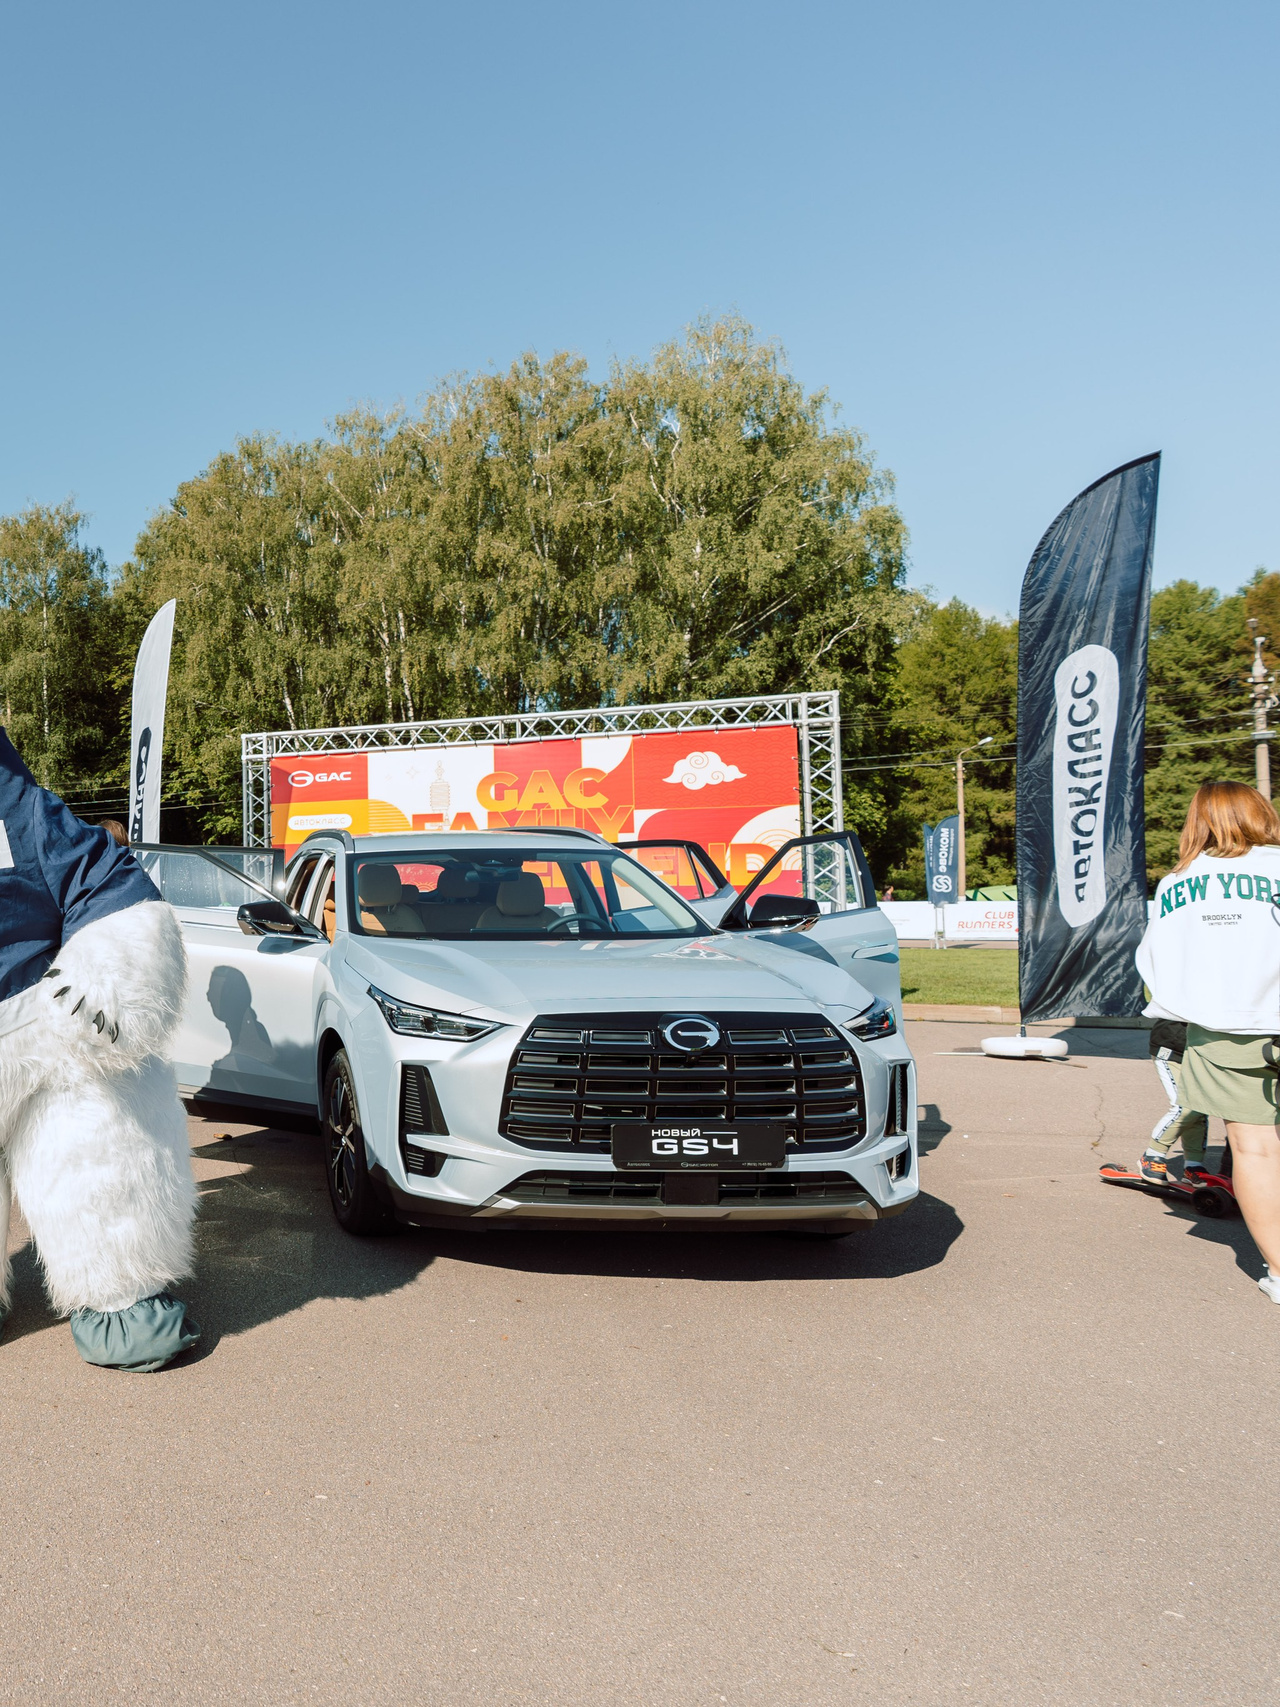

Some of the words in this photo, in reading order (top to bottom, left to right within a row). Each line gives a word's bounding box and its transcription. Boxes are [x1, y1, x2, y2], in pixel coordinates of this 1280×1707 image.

[315, 771, 352, 782] GAC
[476, 767, 610, 812] GAC
[938, 827, 950, 873] ЭВОКОМ
[1160, 873, 1210, 919] NEW
[985, 911, 1015, 920] CLUB
[1202, 913, 1242, 922] BROOKLYN
[958, 921, 1013, 929] RUNNERS
[651, 1128, 701, 1137] НОВЫЙ
[651, 1138, 739, 1156] GS4
